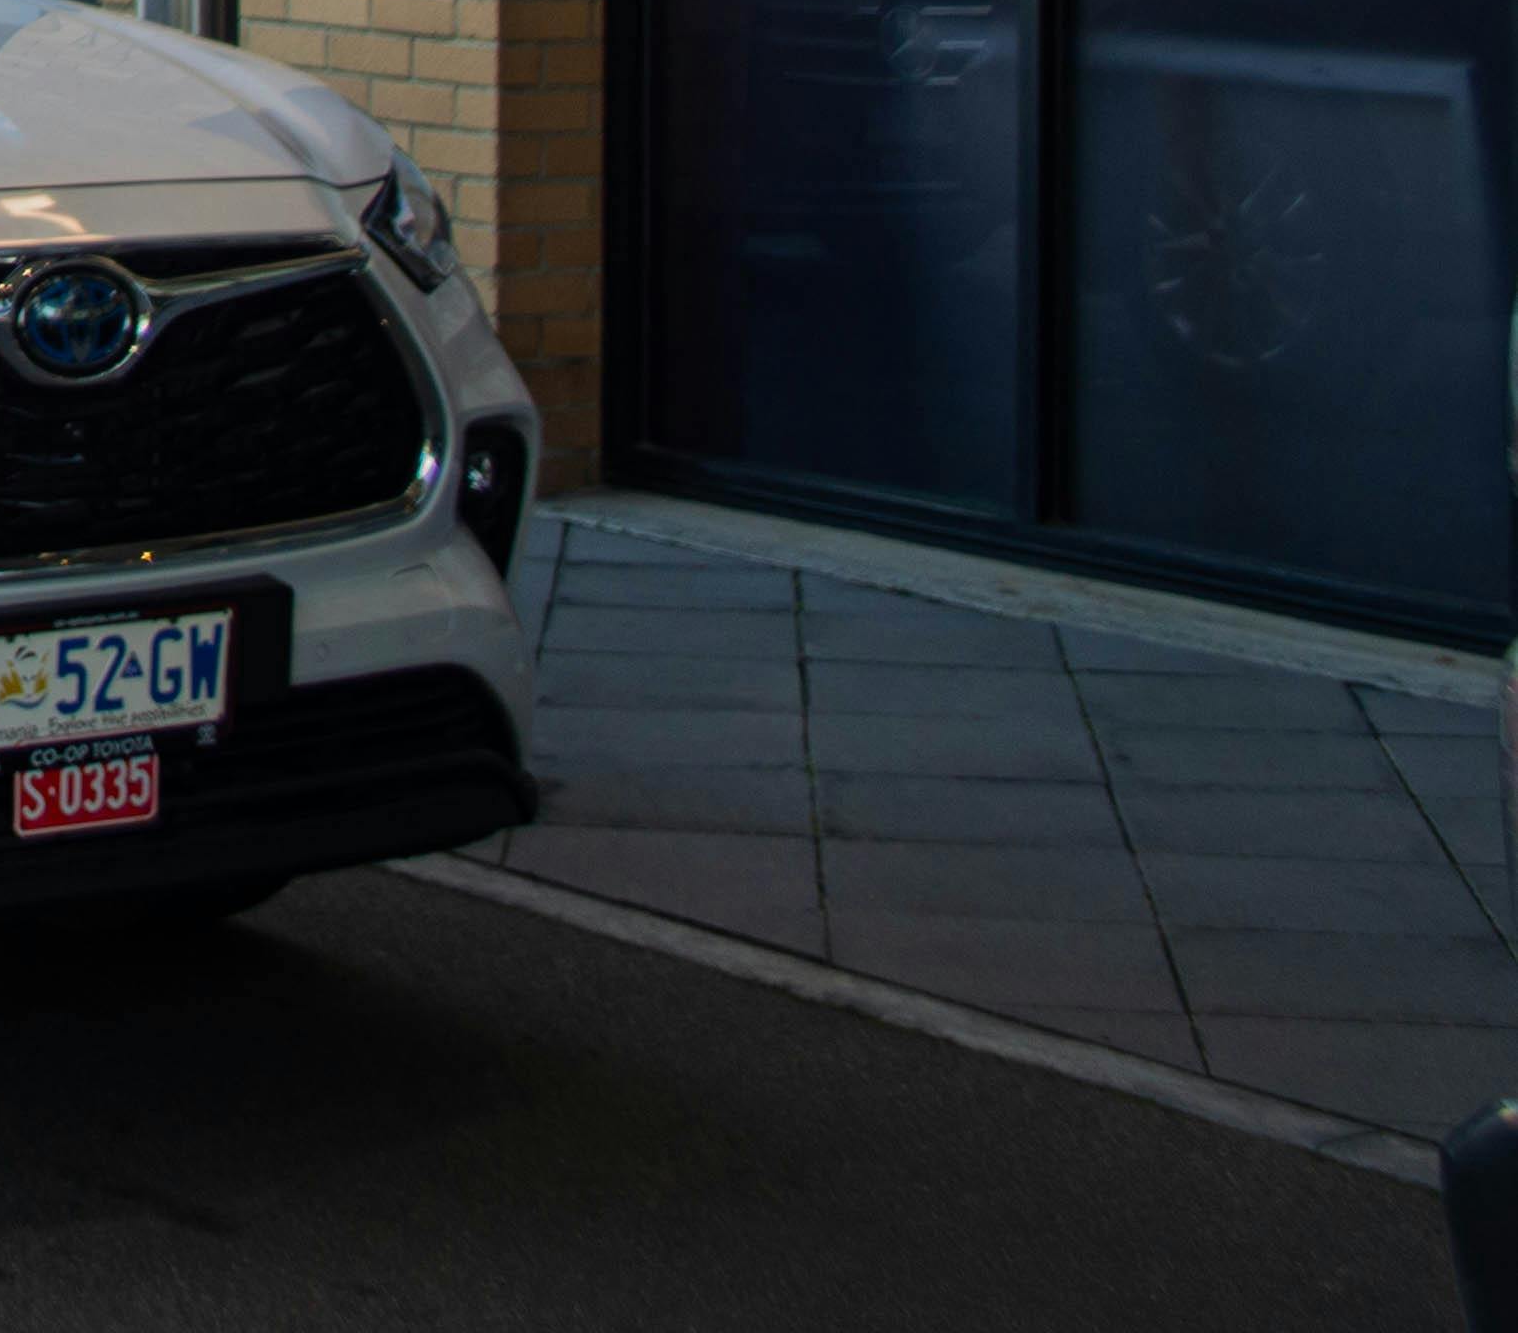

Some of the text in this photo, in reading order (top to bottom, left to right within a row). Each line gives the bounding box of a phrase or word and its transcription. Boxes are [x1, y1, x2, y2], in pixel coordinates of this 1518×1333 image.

[47, 716, 98, 738] Explore
[30, 743, 89, 768] CO-OP
[92, 735, 155, 760] TOYOTA
